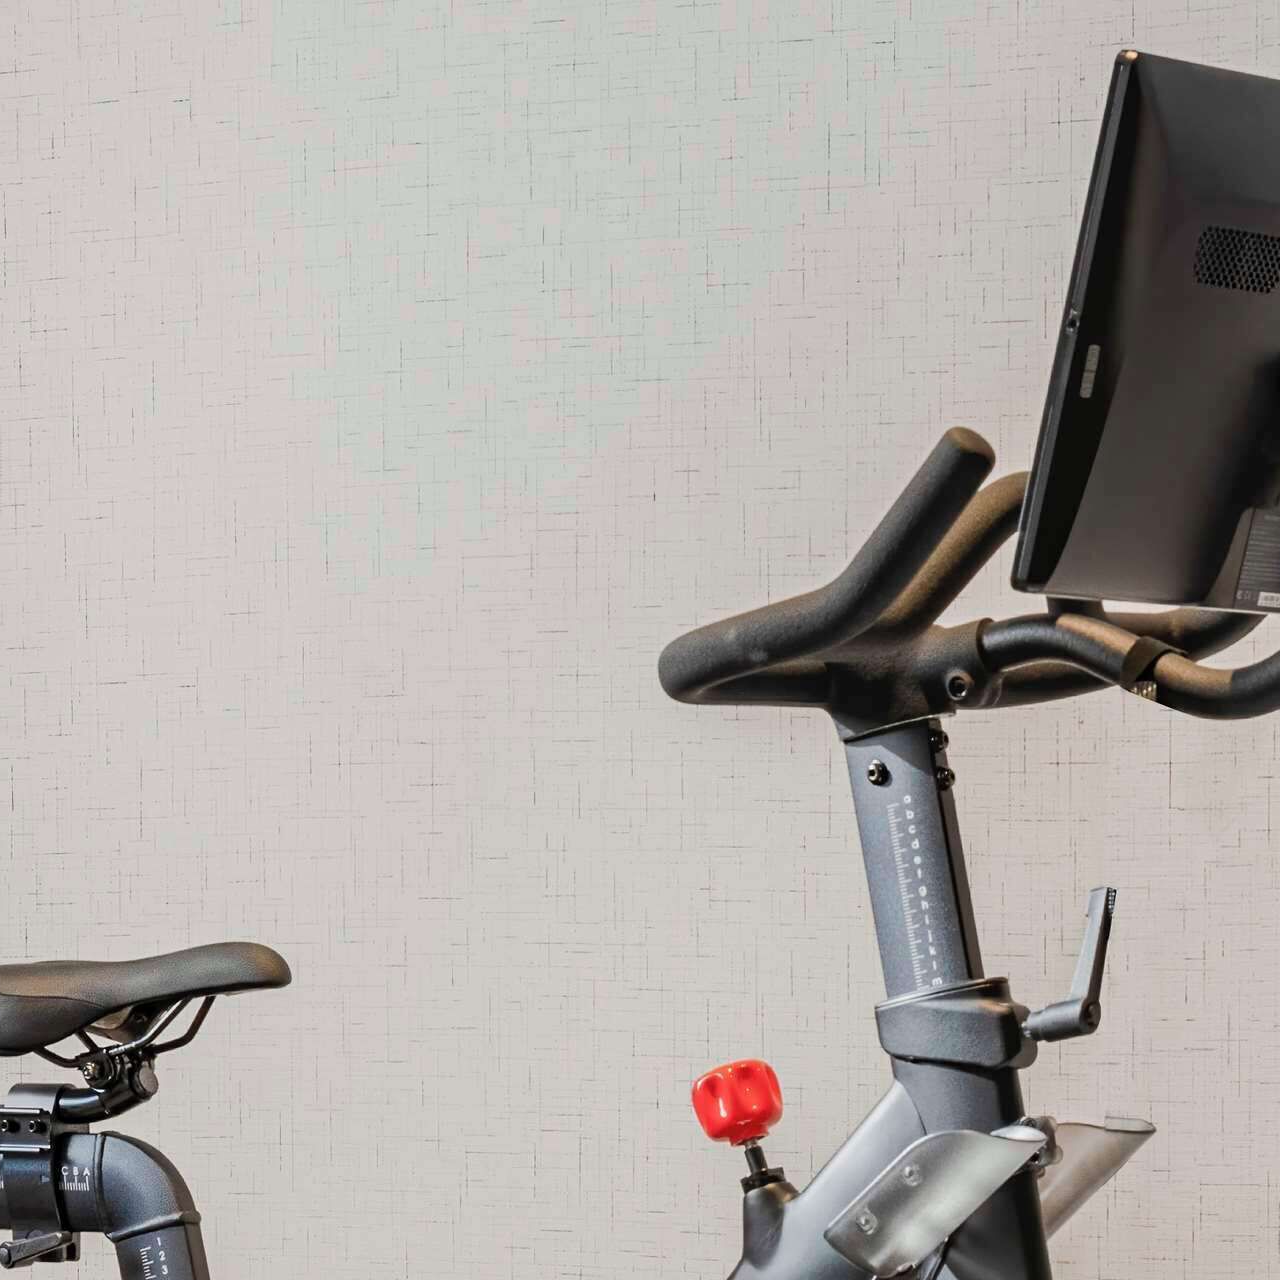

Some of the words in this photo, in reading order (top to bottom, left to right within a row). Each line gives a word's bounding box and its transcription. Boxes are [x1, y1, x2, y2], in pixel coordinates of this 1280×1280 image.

[61, 1166, 68, 1175] C
[73, 1166, 79, 1175] B
[83, 1167, 90, 1175] A
[159, 1251, 166, 1260] 2
[162, 1265, 168, 1275] 3
